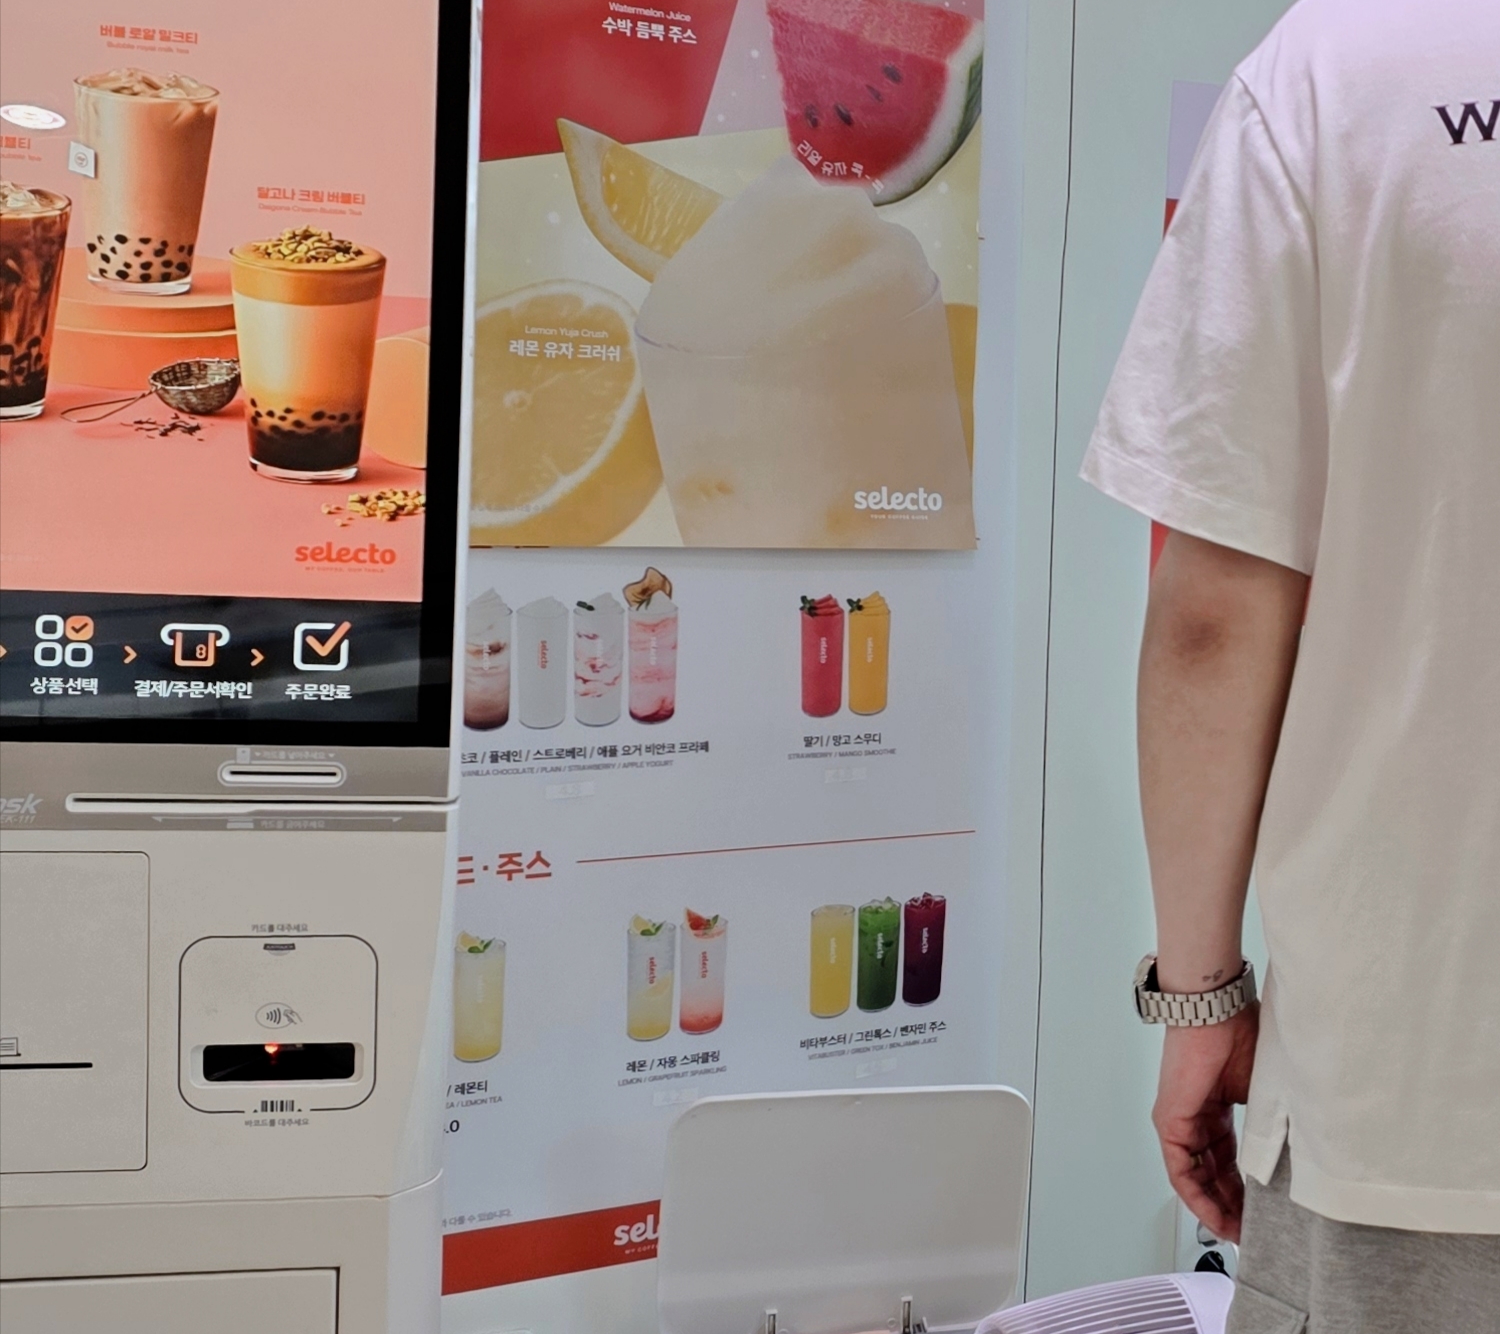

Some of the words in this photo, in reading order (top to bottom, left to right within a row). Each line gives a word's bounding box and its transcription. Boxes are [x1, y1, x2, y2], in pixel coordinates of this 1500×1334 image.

[666, 11, 691, 22] Juice
[602, 17, 633, 37] 수박
[668, 26, 697, 44] 주스
[509, 340, 540, 357] 레몬
[543, 342, 574, 359] 유자
[577, 344, 621, 362] 크러쉬
[854, 486, 942, 511] selecto
[295, 541, 396, 565] selecto
[134, 680, 252, 700] 결제/주문서확인
[285, 684, 352, 701] 주문완료
[803, 735, 824, 748] 딸기
[832, 734, 851, 747] 망고
[853, 732, 881, 745] 스무디
[489, 749, 522, 763] 플레인
[532, 746, 587, 761] 스트로베리
[621, 742, 643, 756] 요거
[645, 740, 676, 755] 비안코
[678, 740, 710, 753] 프라페
[800, 1034, 847, 1050] 비타부스터
[929, 1020, 947, 1033] 주스
[626, 1059, 648, 1073] 레몬
[656, 1055, 678, 1069] 자몽
[454, 1080, 488, 1095] 레몬티
